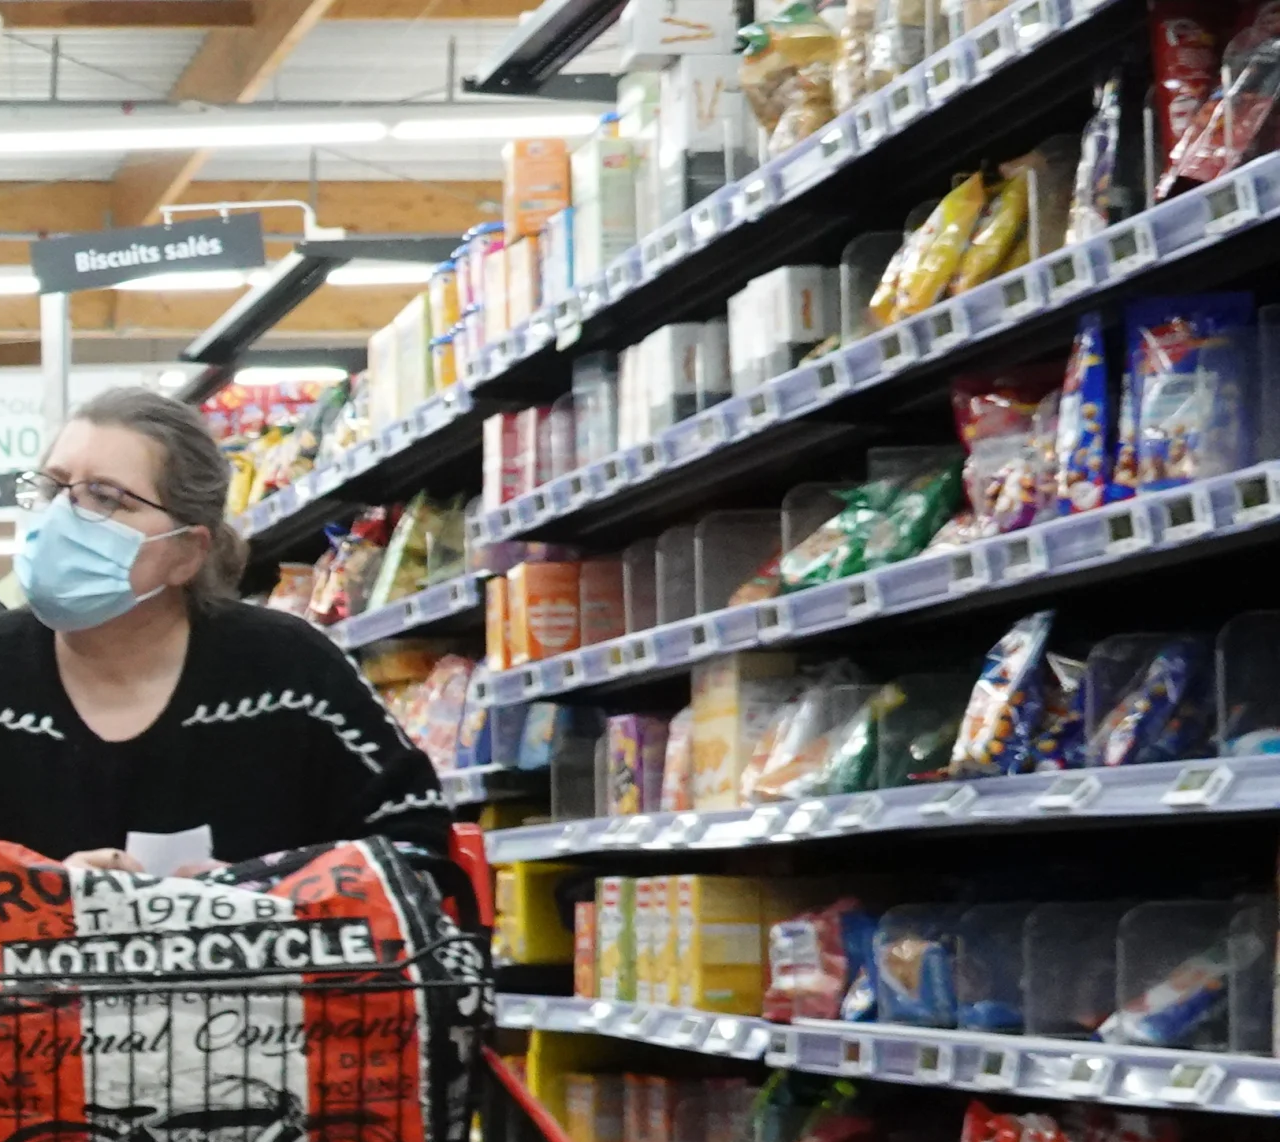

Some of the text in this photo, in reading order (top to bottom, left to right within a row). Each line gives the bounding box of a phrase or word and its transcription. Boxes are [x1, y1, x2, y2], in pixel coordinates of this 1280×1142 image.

[74, 234, 224, 273] Biscuits salés
[128, 894, 238, 927] 1976
[3, 922, 378, 975] MOTORCYCLE
[195, 1009, 421, 1058] Company
